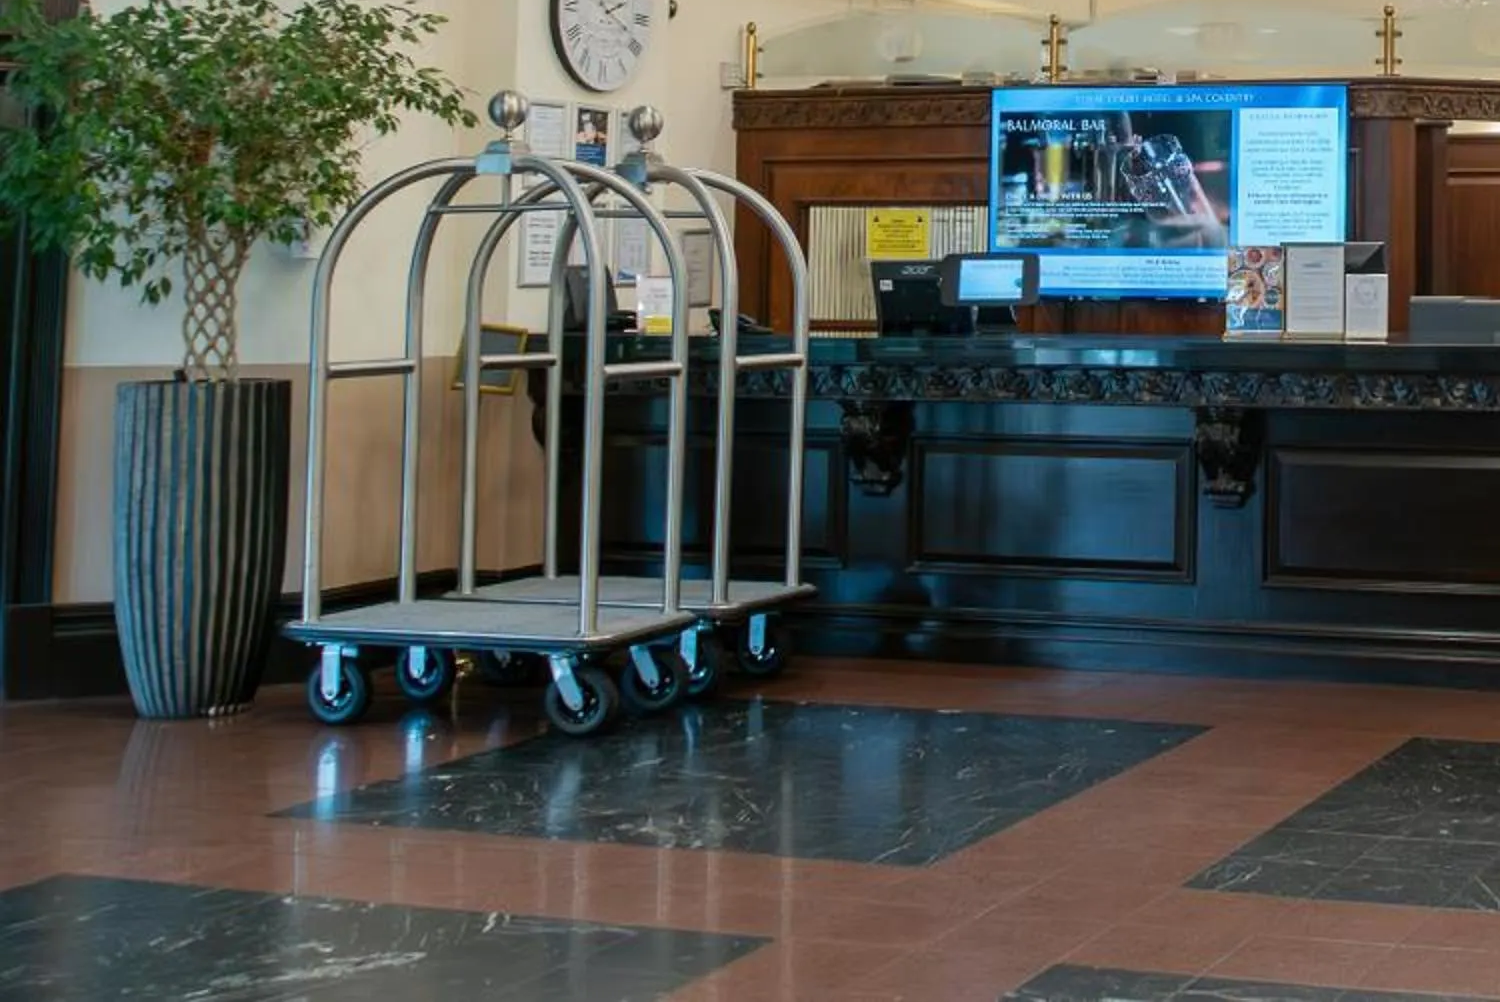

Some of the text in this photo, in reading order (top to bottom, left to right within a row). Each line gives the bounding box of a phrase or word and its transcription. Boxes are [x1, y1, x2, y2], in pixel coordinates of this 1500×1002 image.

[1007, 119, 1105, 133] BALMORAL BAR
[901, 264, 934, 275] acer
